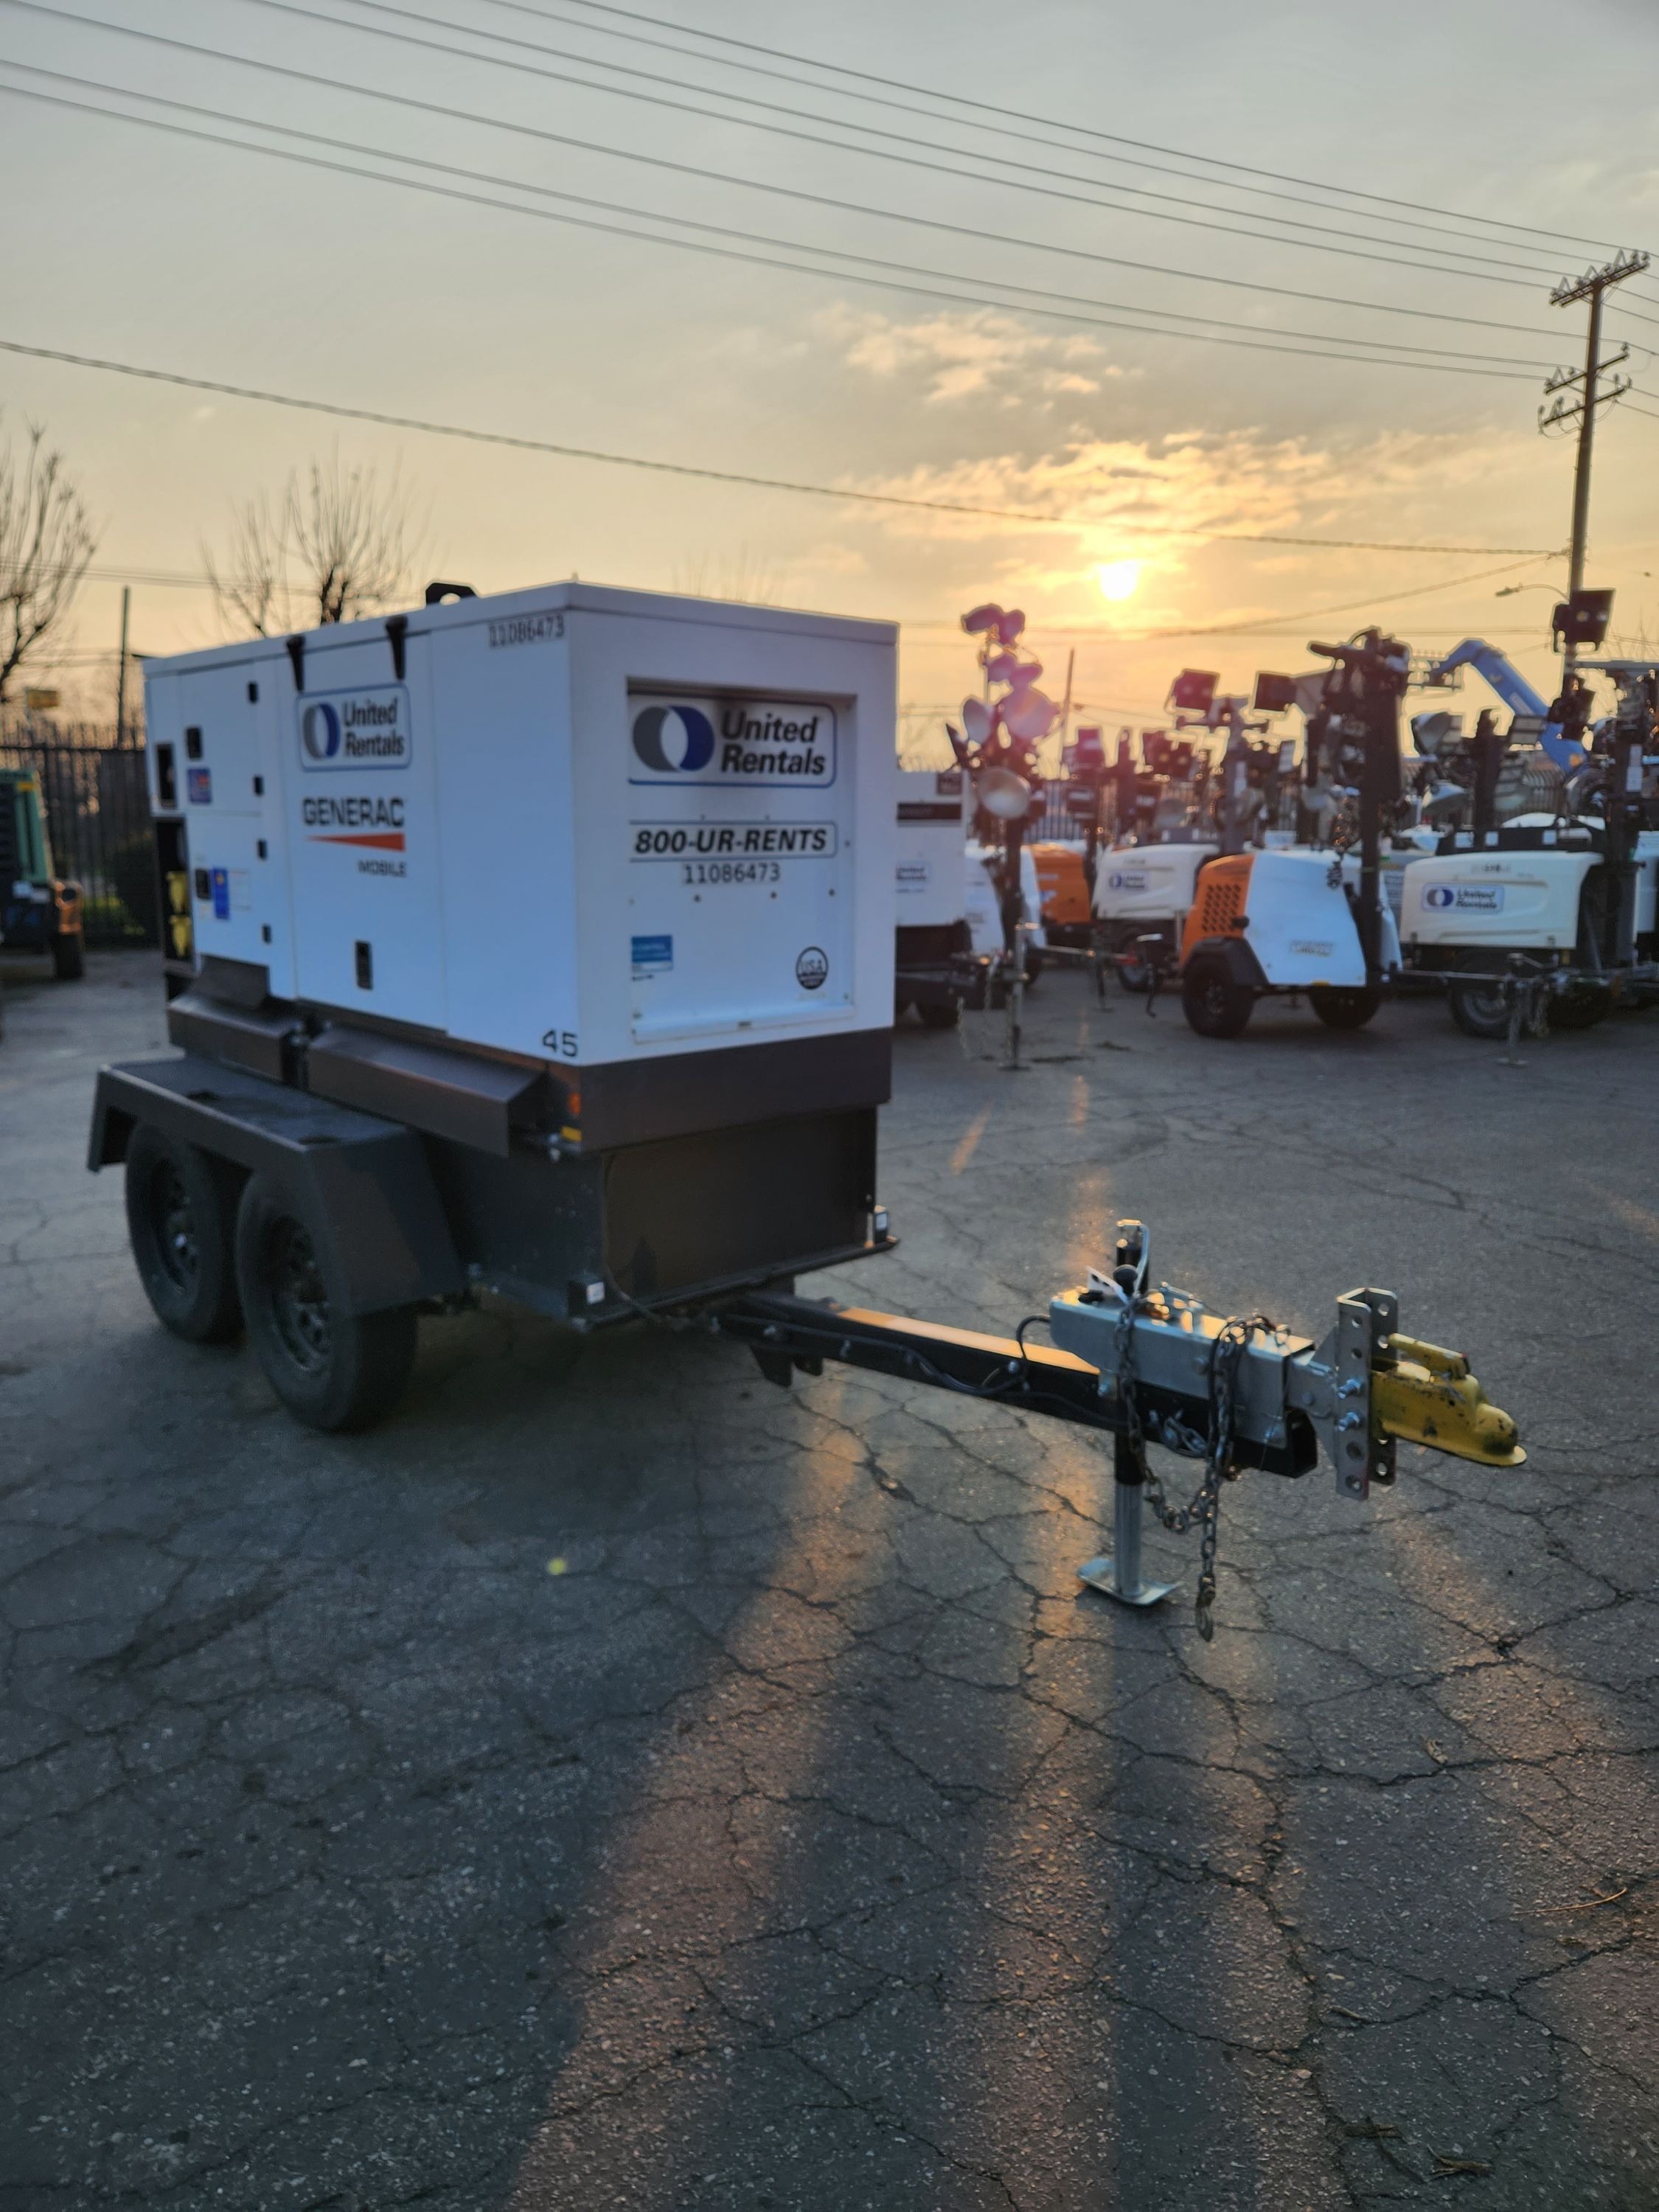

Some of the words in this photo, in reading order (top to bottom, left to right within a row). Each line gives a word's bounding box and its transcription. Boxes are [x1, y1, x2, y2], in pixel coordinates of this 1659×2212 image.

[342, 696, 398, 727] United
[720, 710, 818, 743] United
[344, 730, 405, 757] Rentals
[720, 743, 826, 775] Rentals
[302, 796, 406, 827] GENERAC
[635, 829, 827, 854] 800-UR-RENTS
[358, 860, 407, 877] MOBILE
[685, 863, 781, 885] 11086473
[542, 1030, 578, 1057] 45
